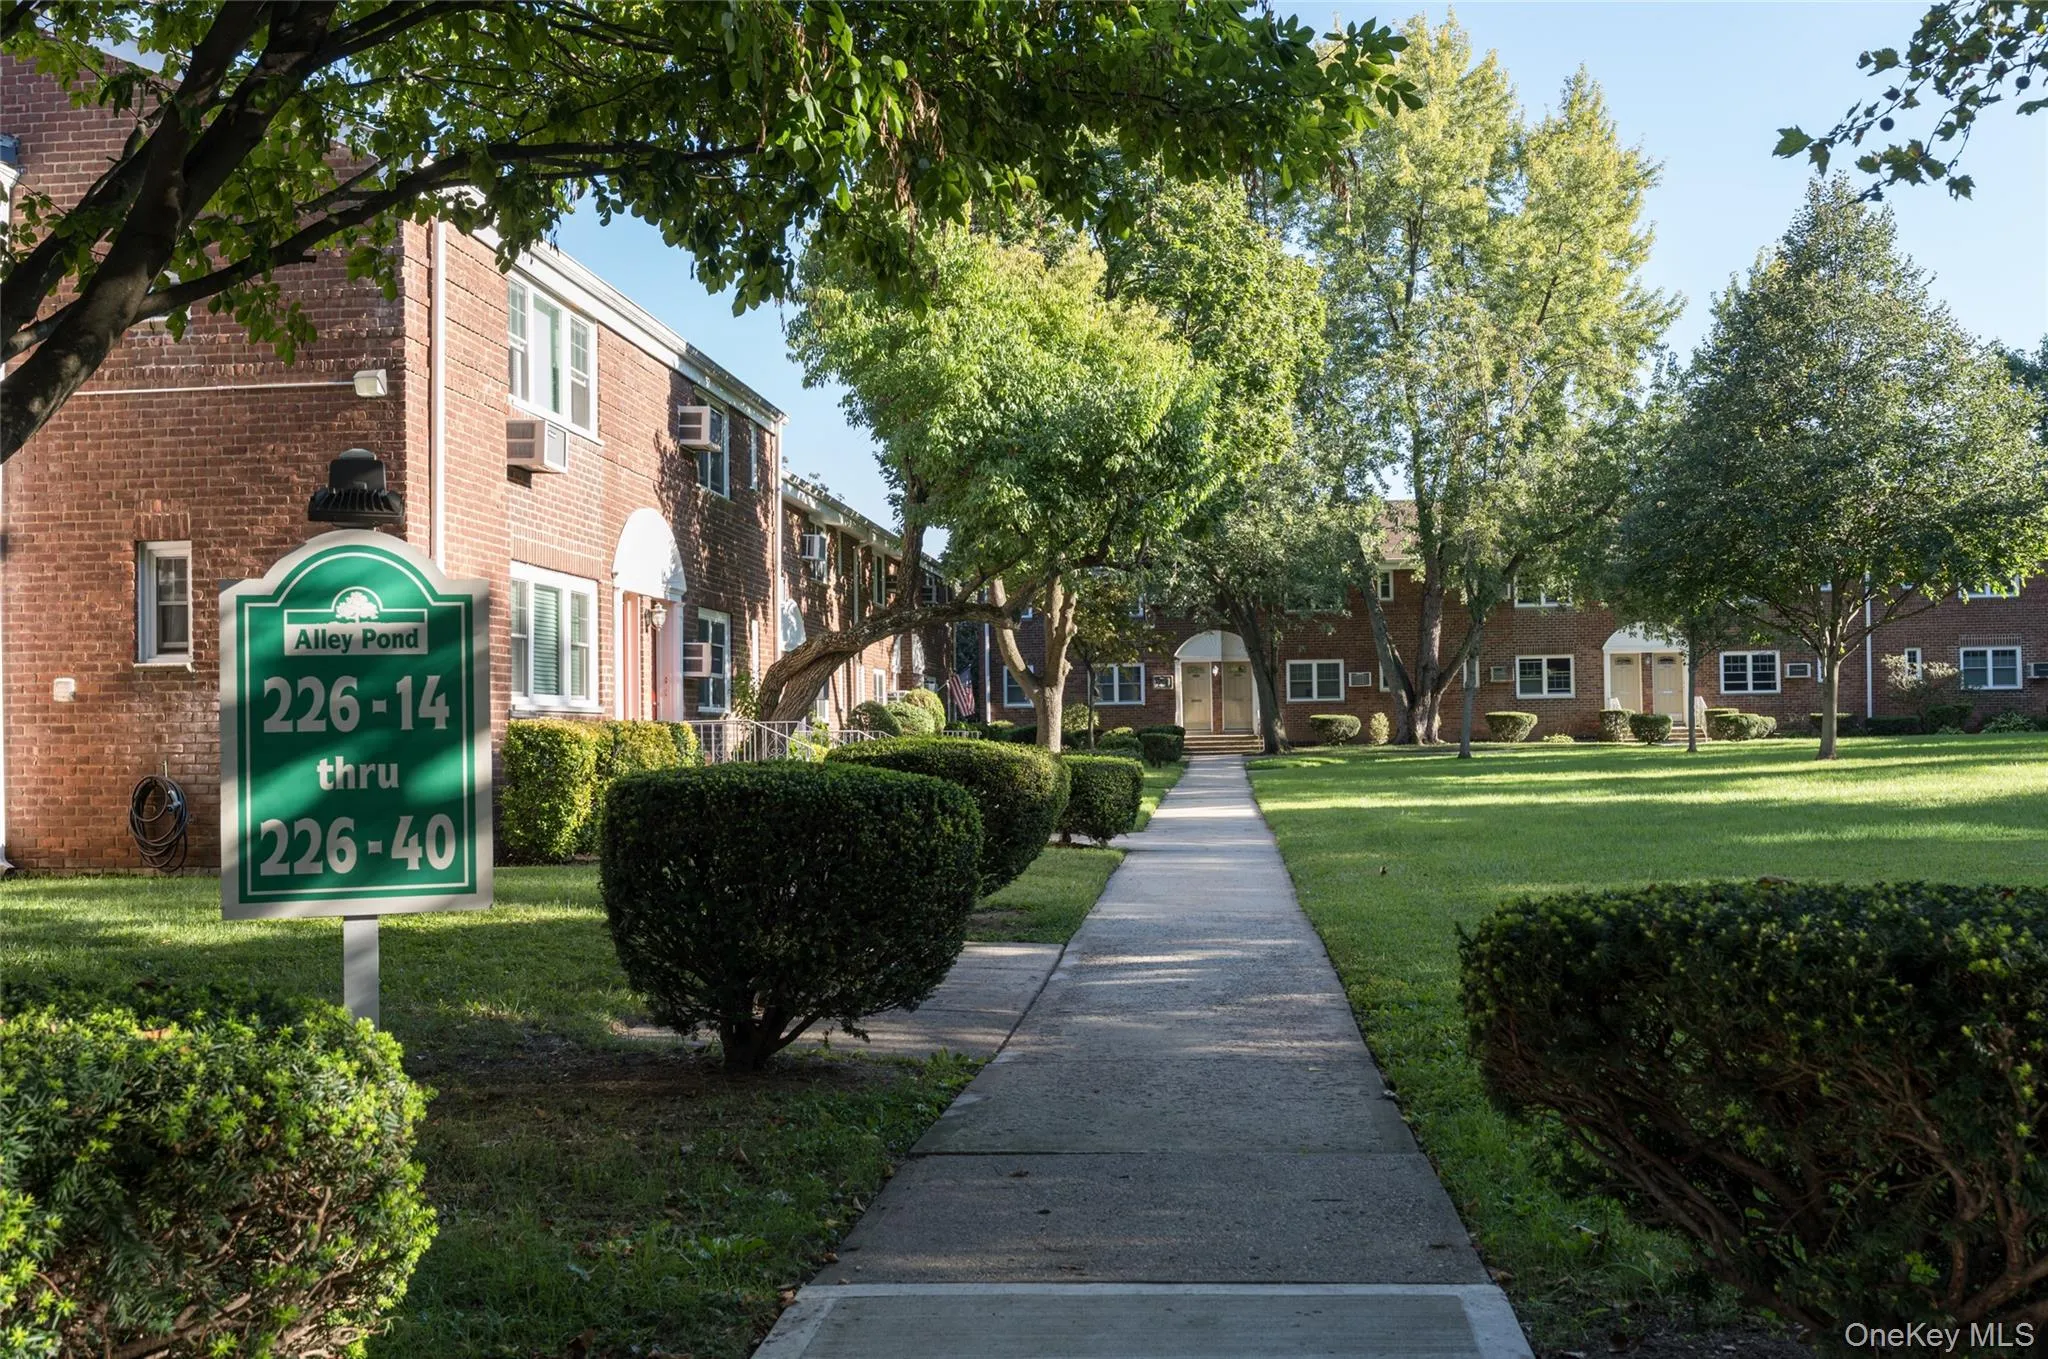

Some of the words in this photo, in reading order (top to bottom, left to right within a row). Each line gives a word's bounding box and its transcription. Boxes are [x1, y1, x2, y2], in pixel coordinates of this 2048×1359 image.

[294, 627, 353, 654] Alley
[361, 627, 420, 650] Pond
[315, 755, 400, 791] thru
